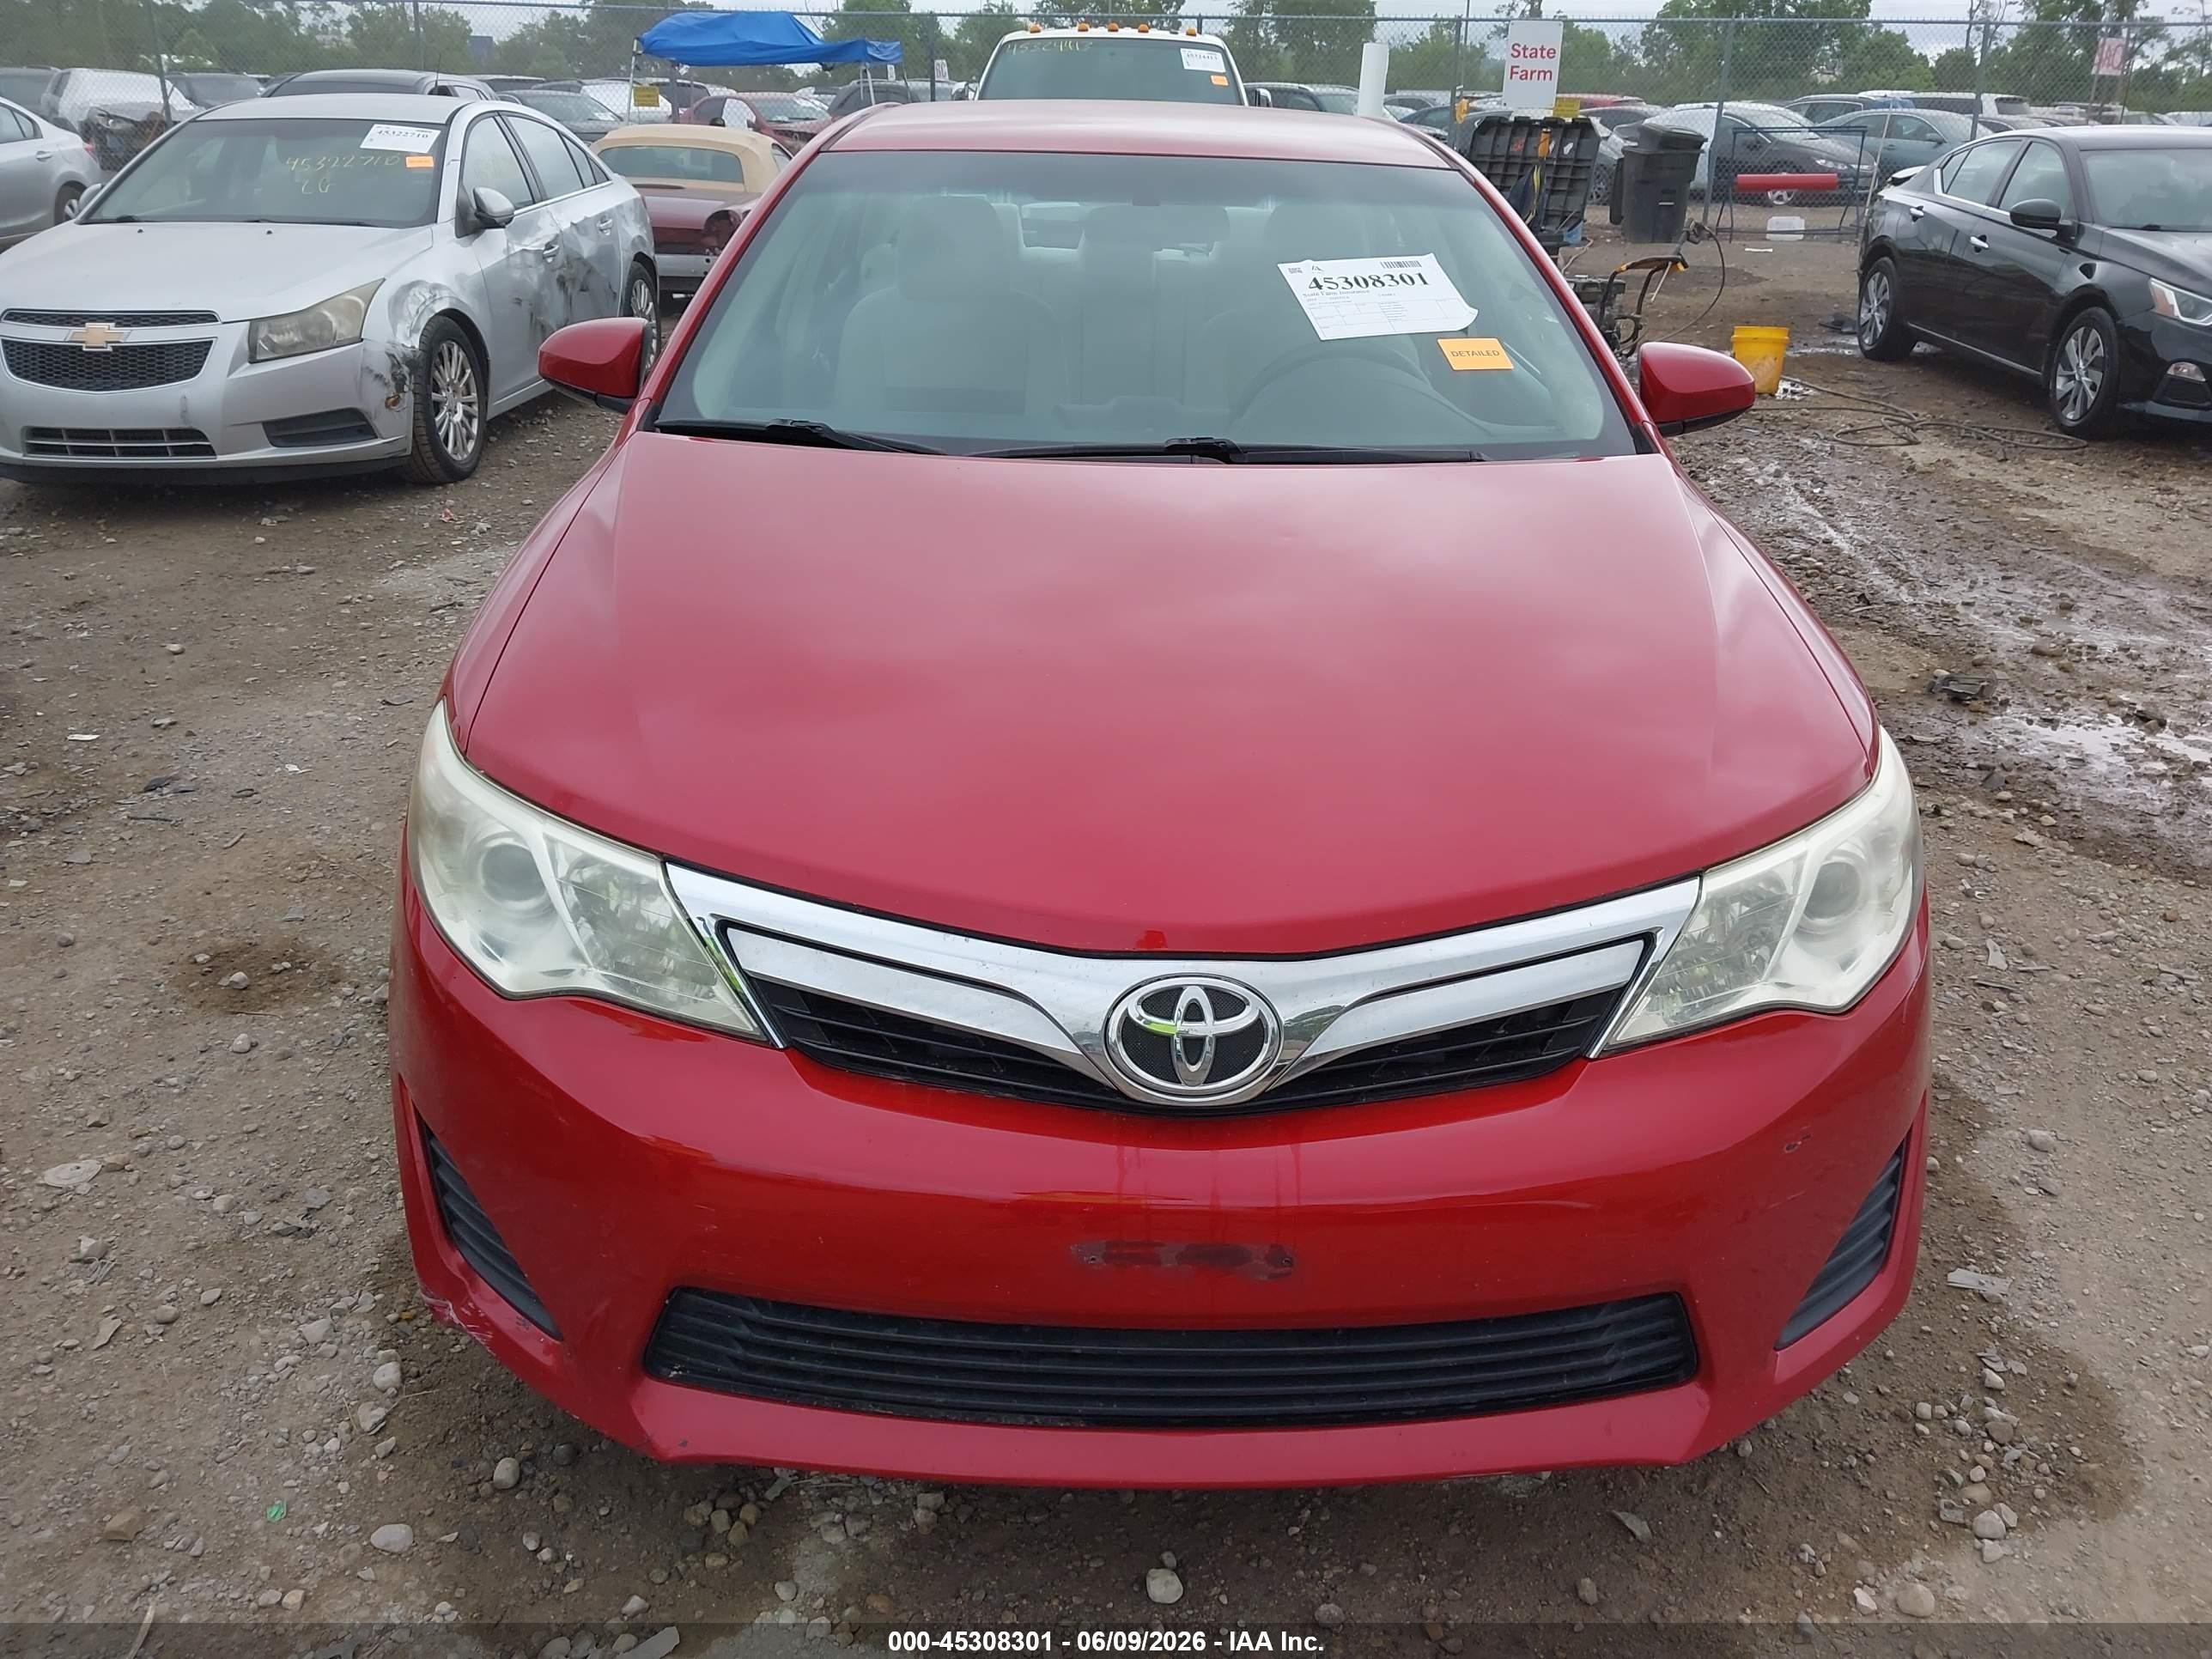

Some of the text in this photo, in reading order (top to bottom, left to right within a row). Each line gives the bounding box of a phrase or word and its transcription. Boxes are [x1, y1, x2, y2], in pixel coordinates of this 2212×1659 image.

[1510, 43, 1557, 59] State
[1510, 65, 1553, 81] Farm
[1308, 272, 1431, 290] 45308301
